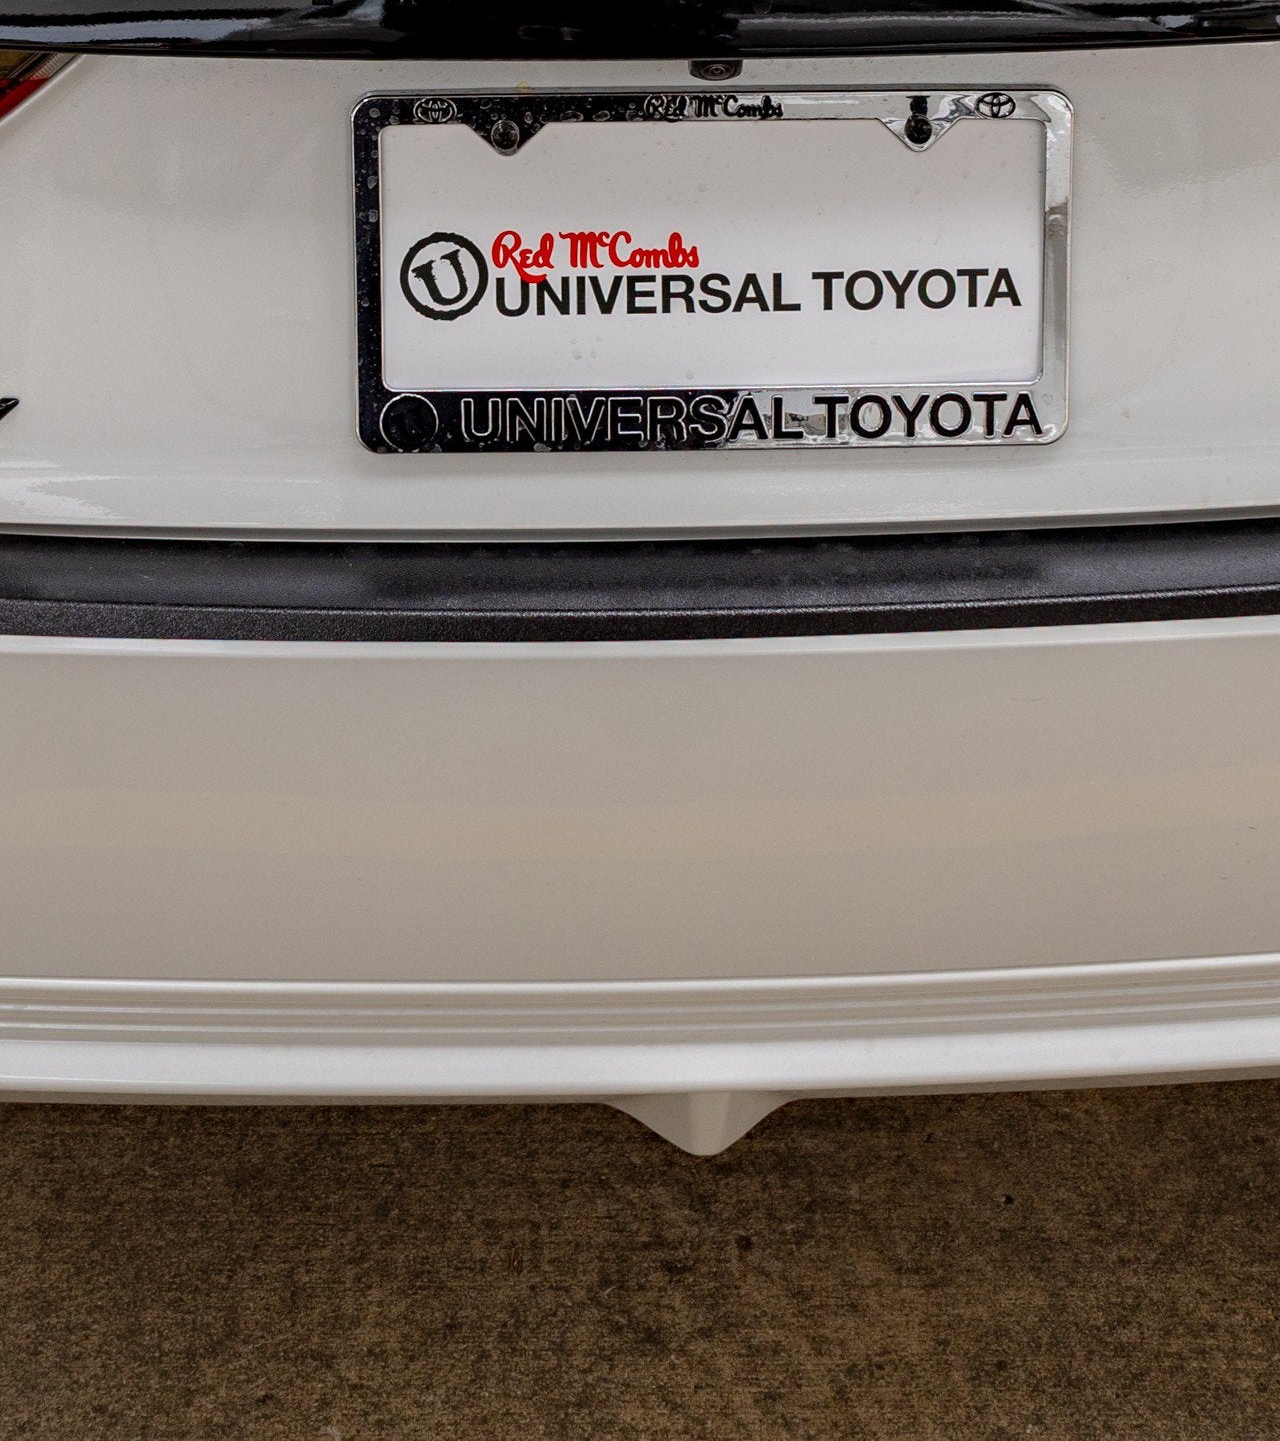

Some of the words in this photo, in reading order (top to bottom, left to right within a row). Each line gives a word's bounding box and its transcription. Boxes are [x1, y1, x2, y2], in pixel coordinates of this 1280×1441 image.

[645, 93, 689, 123] Red
[690, 93, 784, 120] McCombs
[491, 230, 554, 283] Red
[558, 230, 700, 269] McCombs
[495, 271, 801, 317] UNIVERSAL
[811, 268, 1022, 312] TOYOTA
[460, 395, 805, 443] UNIVERSAL
[813, 392, 1044, 440] TOYOTA
